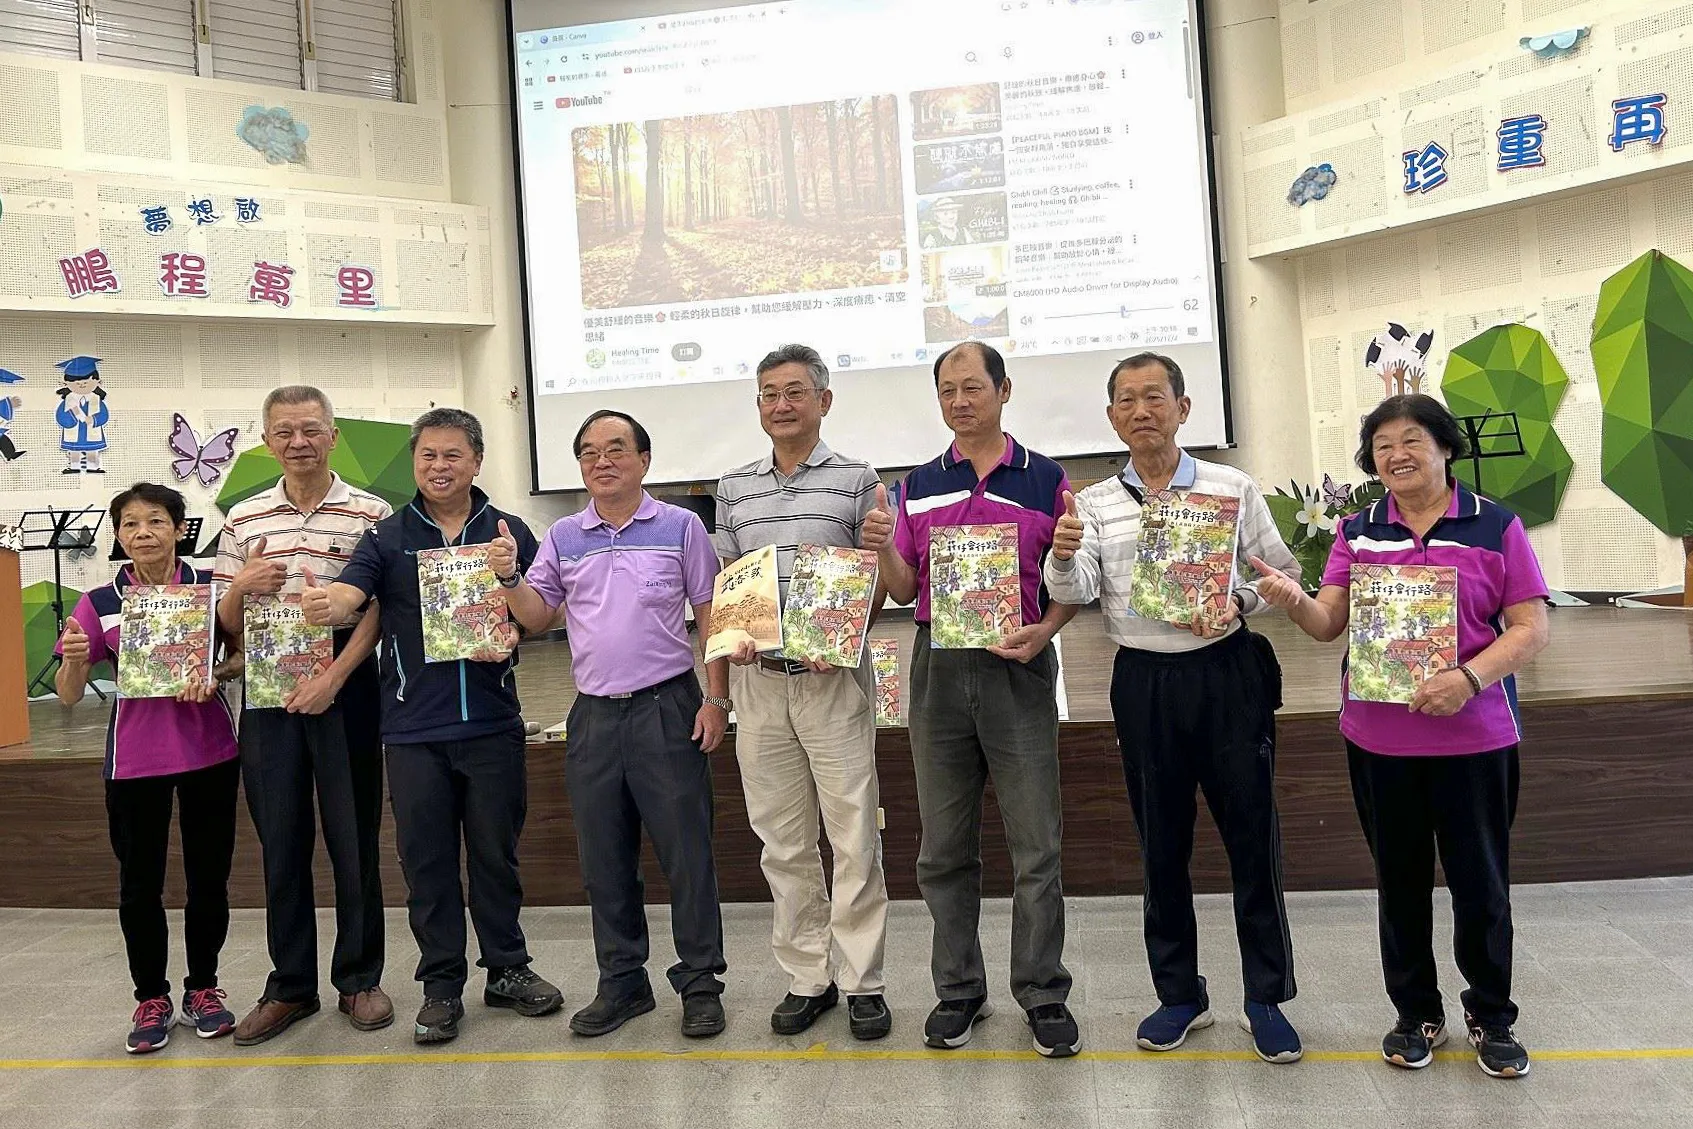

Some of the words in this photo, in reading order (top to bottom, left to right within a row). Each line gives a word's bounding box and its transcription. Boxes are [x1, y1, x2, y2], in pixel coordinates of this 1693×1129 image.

[571, 95, 603, 108] YouTube
[1402, 92, 1666, 193] 珍重再
[142, 197, 262, 235] 夢想啟
[58, 248, 377, 307] 鵬程萬里
[1061, 284, 1085, 294] Audio
[1110, 281, 1121, 290] for
[1123, 278, 1151, 289] Display
[1183, 298, 1200, 311] 62
[611, 348, 639, 358] Healing
[641, 346, 660, 355] Time
[261, 607, 305, 620] 莊仔會行
